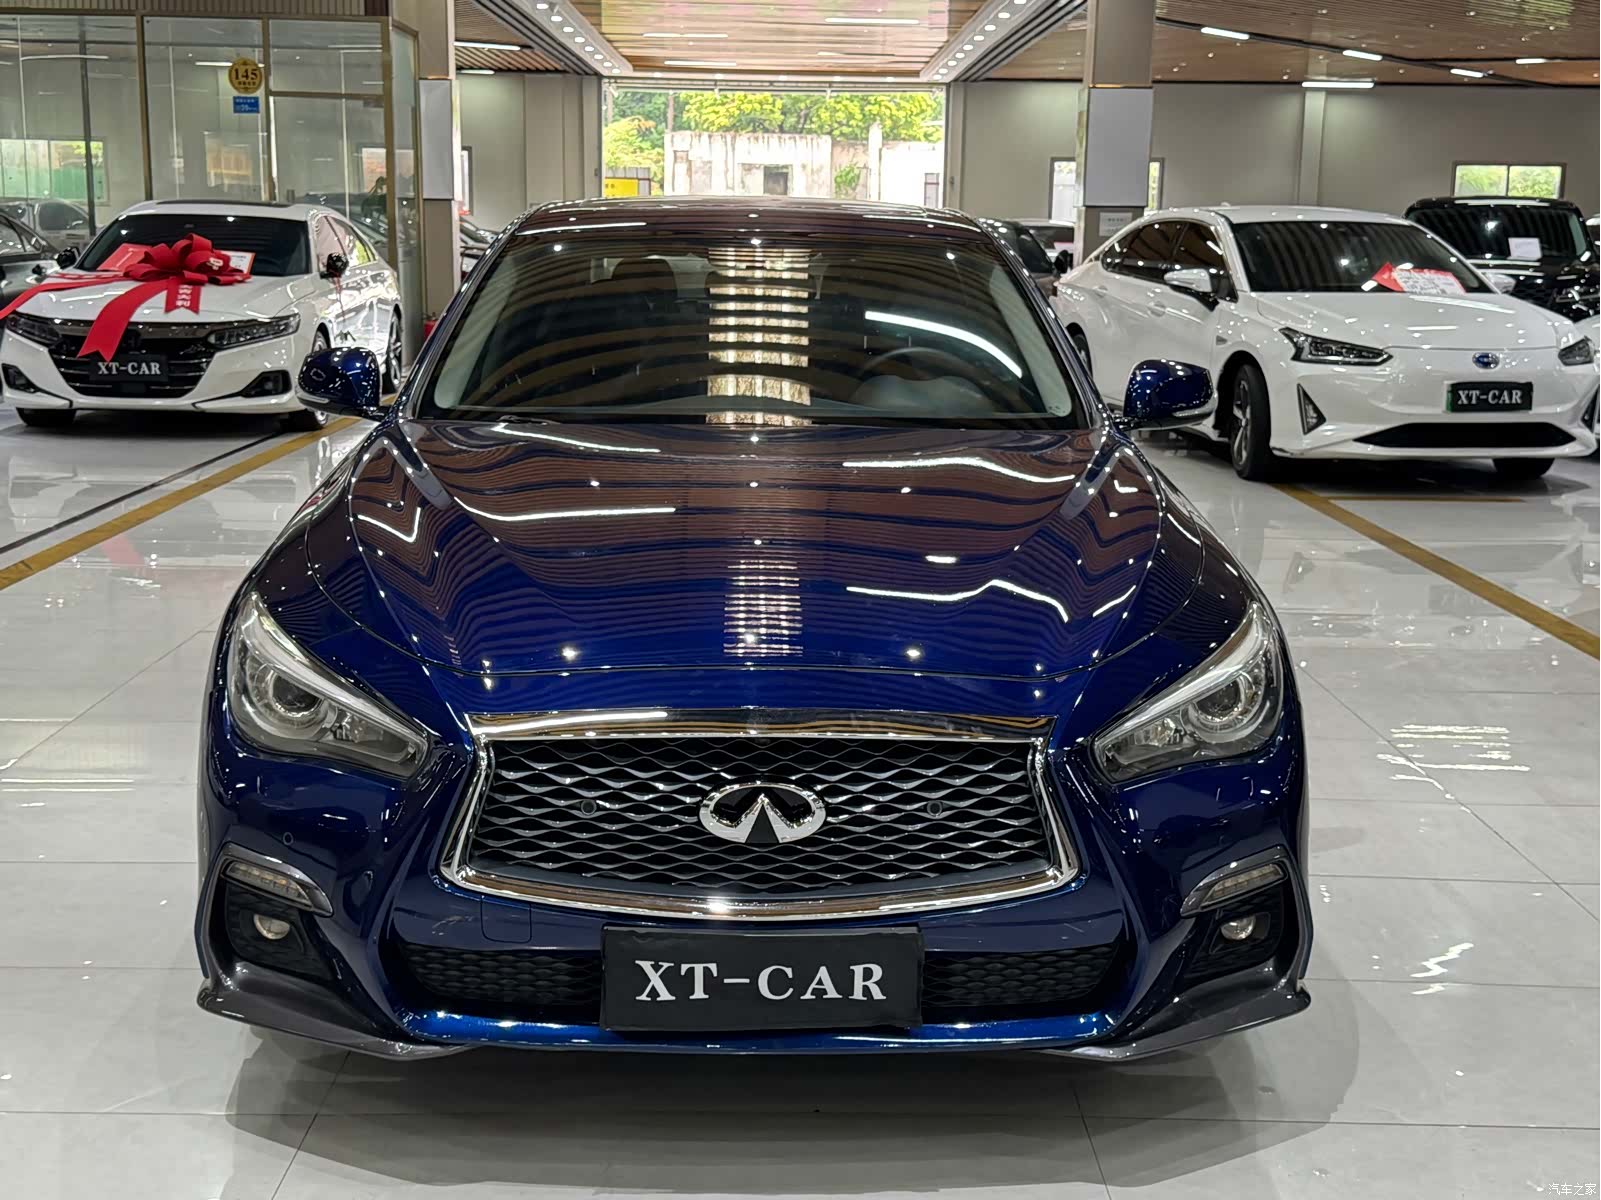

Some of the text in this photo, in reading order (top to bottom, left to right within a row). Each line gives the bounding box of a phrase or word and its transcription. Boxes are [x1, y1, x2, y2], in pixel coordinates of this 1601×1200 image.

[234, 68, 258, 80] 145
[98, 361, 161, 375] XT-CAR
[1457, 389, 1522, 405] XT-CAR
[635, 960, 887, 1001] XT-CAR
